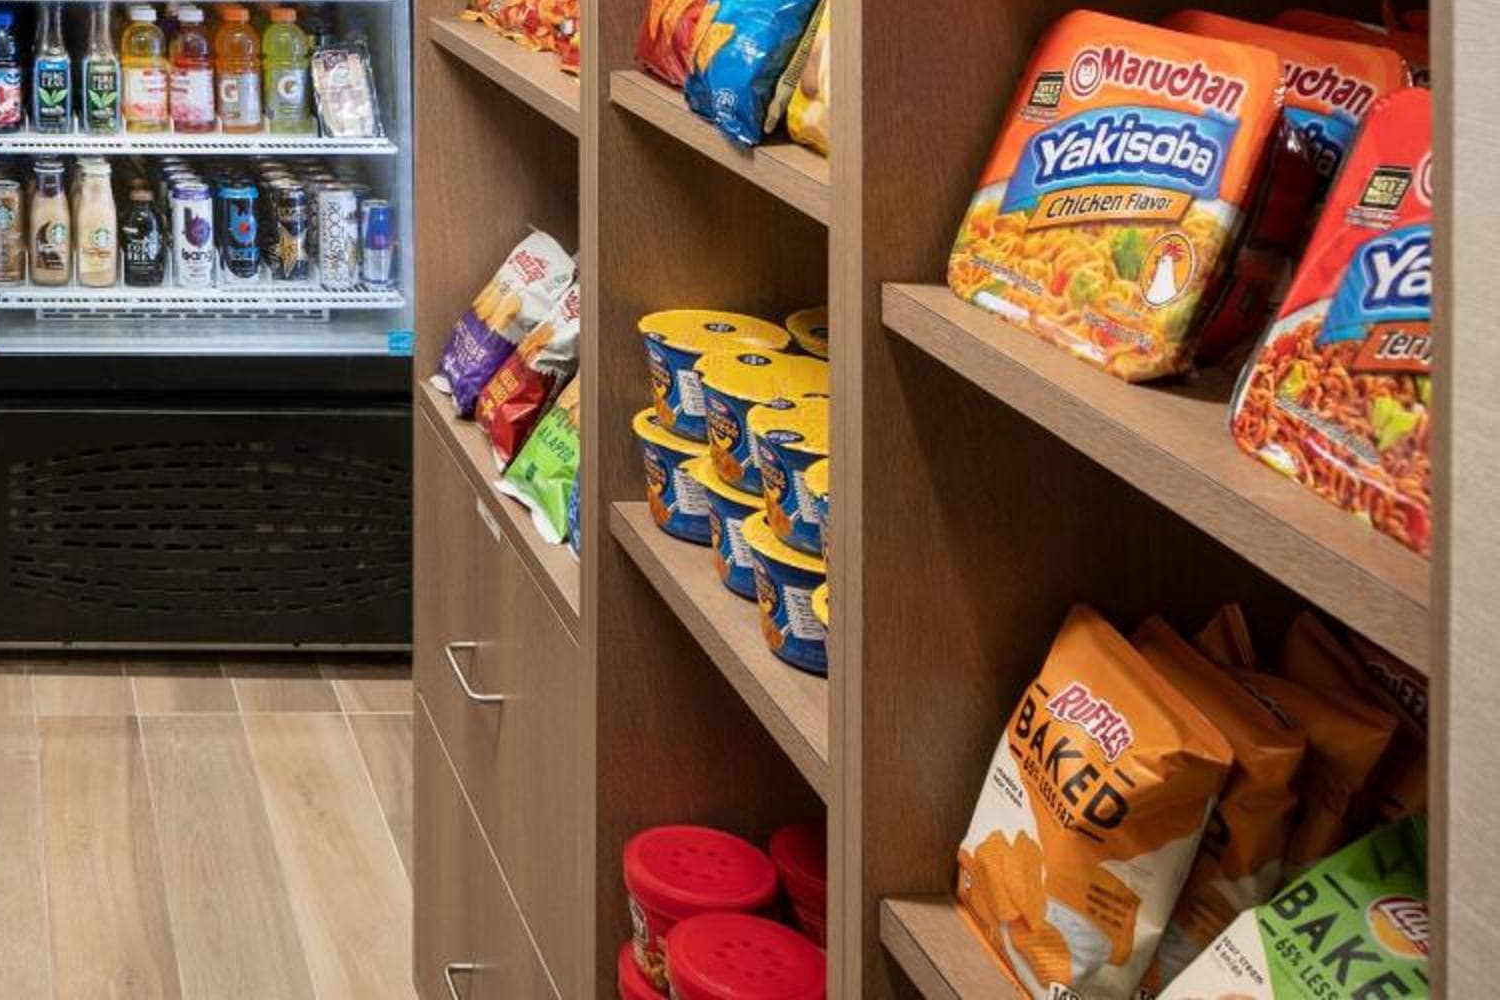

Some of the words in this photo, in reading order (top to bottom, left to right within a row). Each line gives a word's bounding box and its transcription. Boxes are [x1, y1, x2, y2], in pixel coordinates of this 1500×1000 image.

[1100, 47, 1244, 113] Maruchan
[1284, 63, 1376, 117] uchan
[1040, 118, 1215, 178] Yakisoba
[1045, 194, 1124, 218] Chicken
[1124, 193, 1173, 211] Flavor
[1048, 683, 1133, 762] RUFFLES
[1015, 694, 1130, 830] BAKED
[1270, 880, 1412, 1000] BAKE
[1275, 937, 1304, 966] 65%
